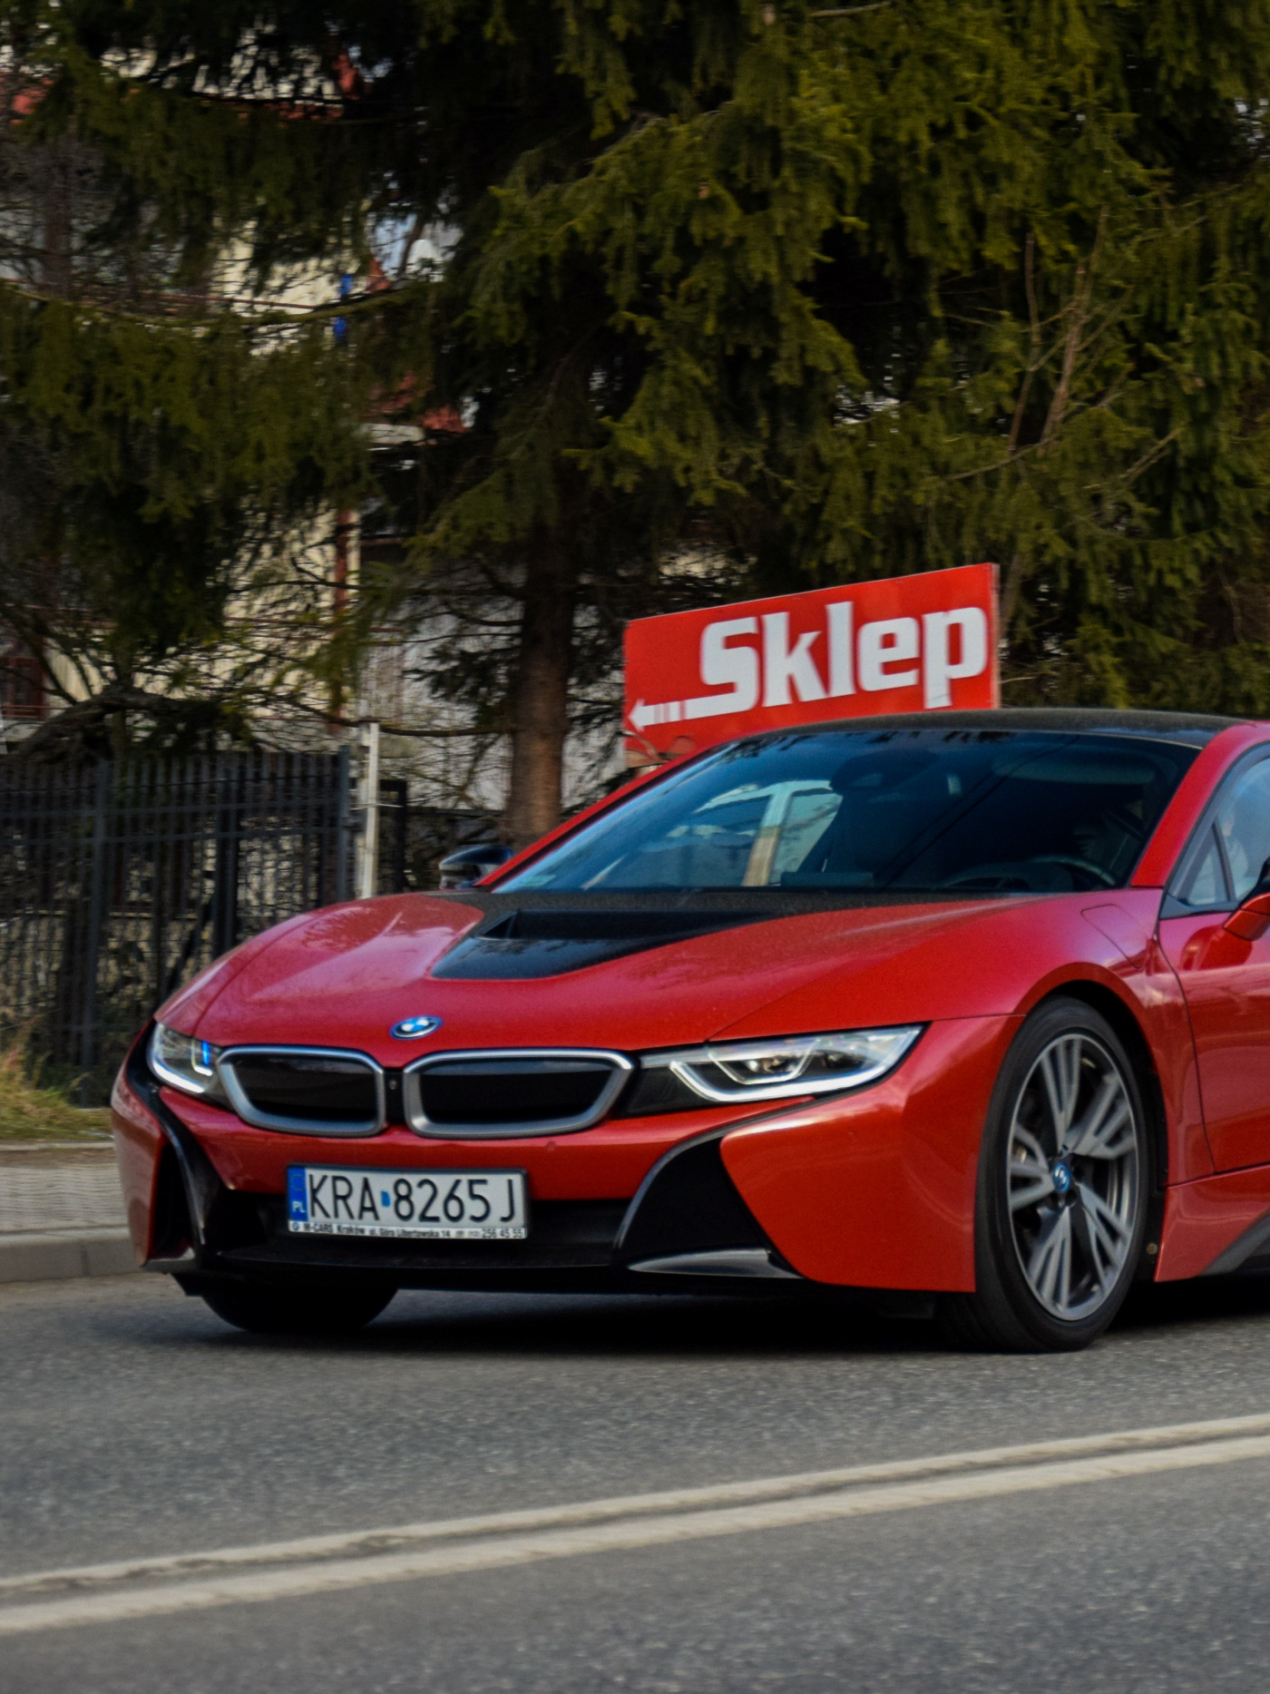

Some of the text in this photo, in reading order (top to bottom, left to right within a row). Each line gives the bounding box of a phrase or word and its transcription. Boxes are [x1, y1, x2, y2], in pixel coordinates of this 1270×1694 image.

[701, 600, 986, 711] Sklep
[292, 1201, 305, 1213] PL
[309, 1174, 515, 1223] KRA 8265J
